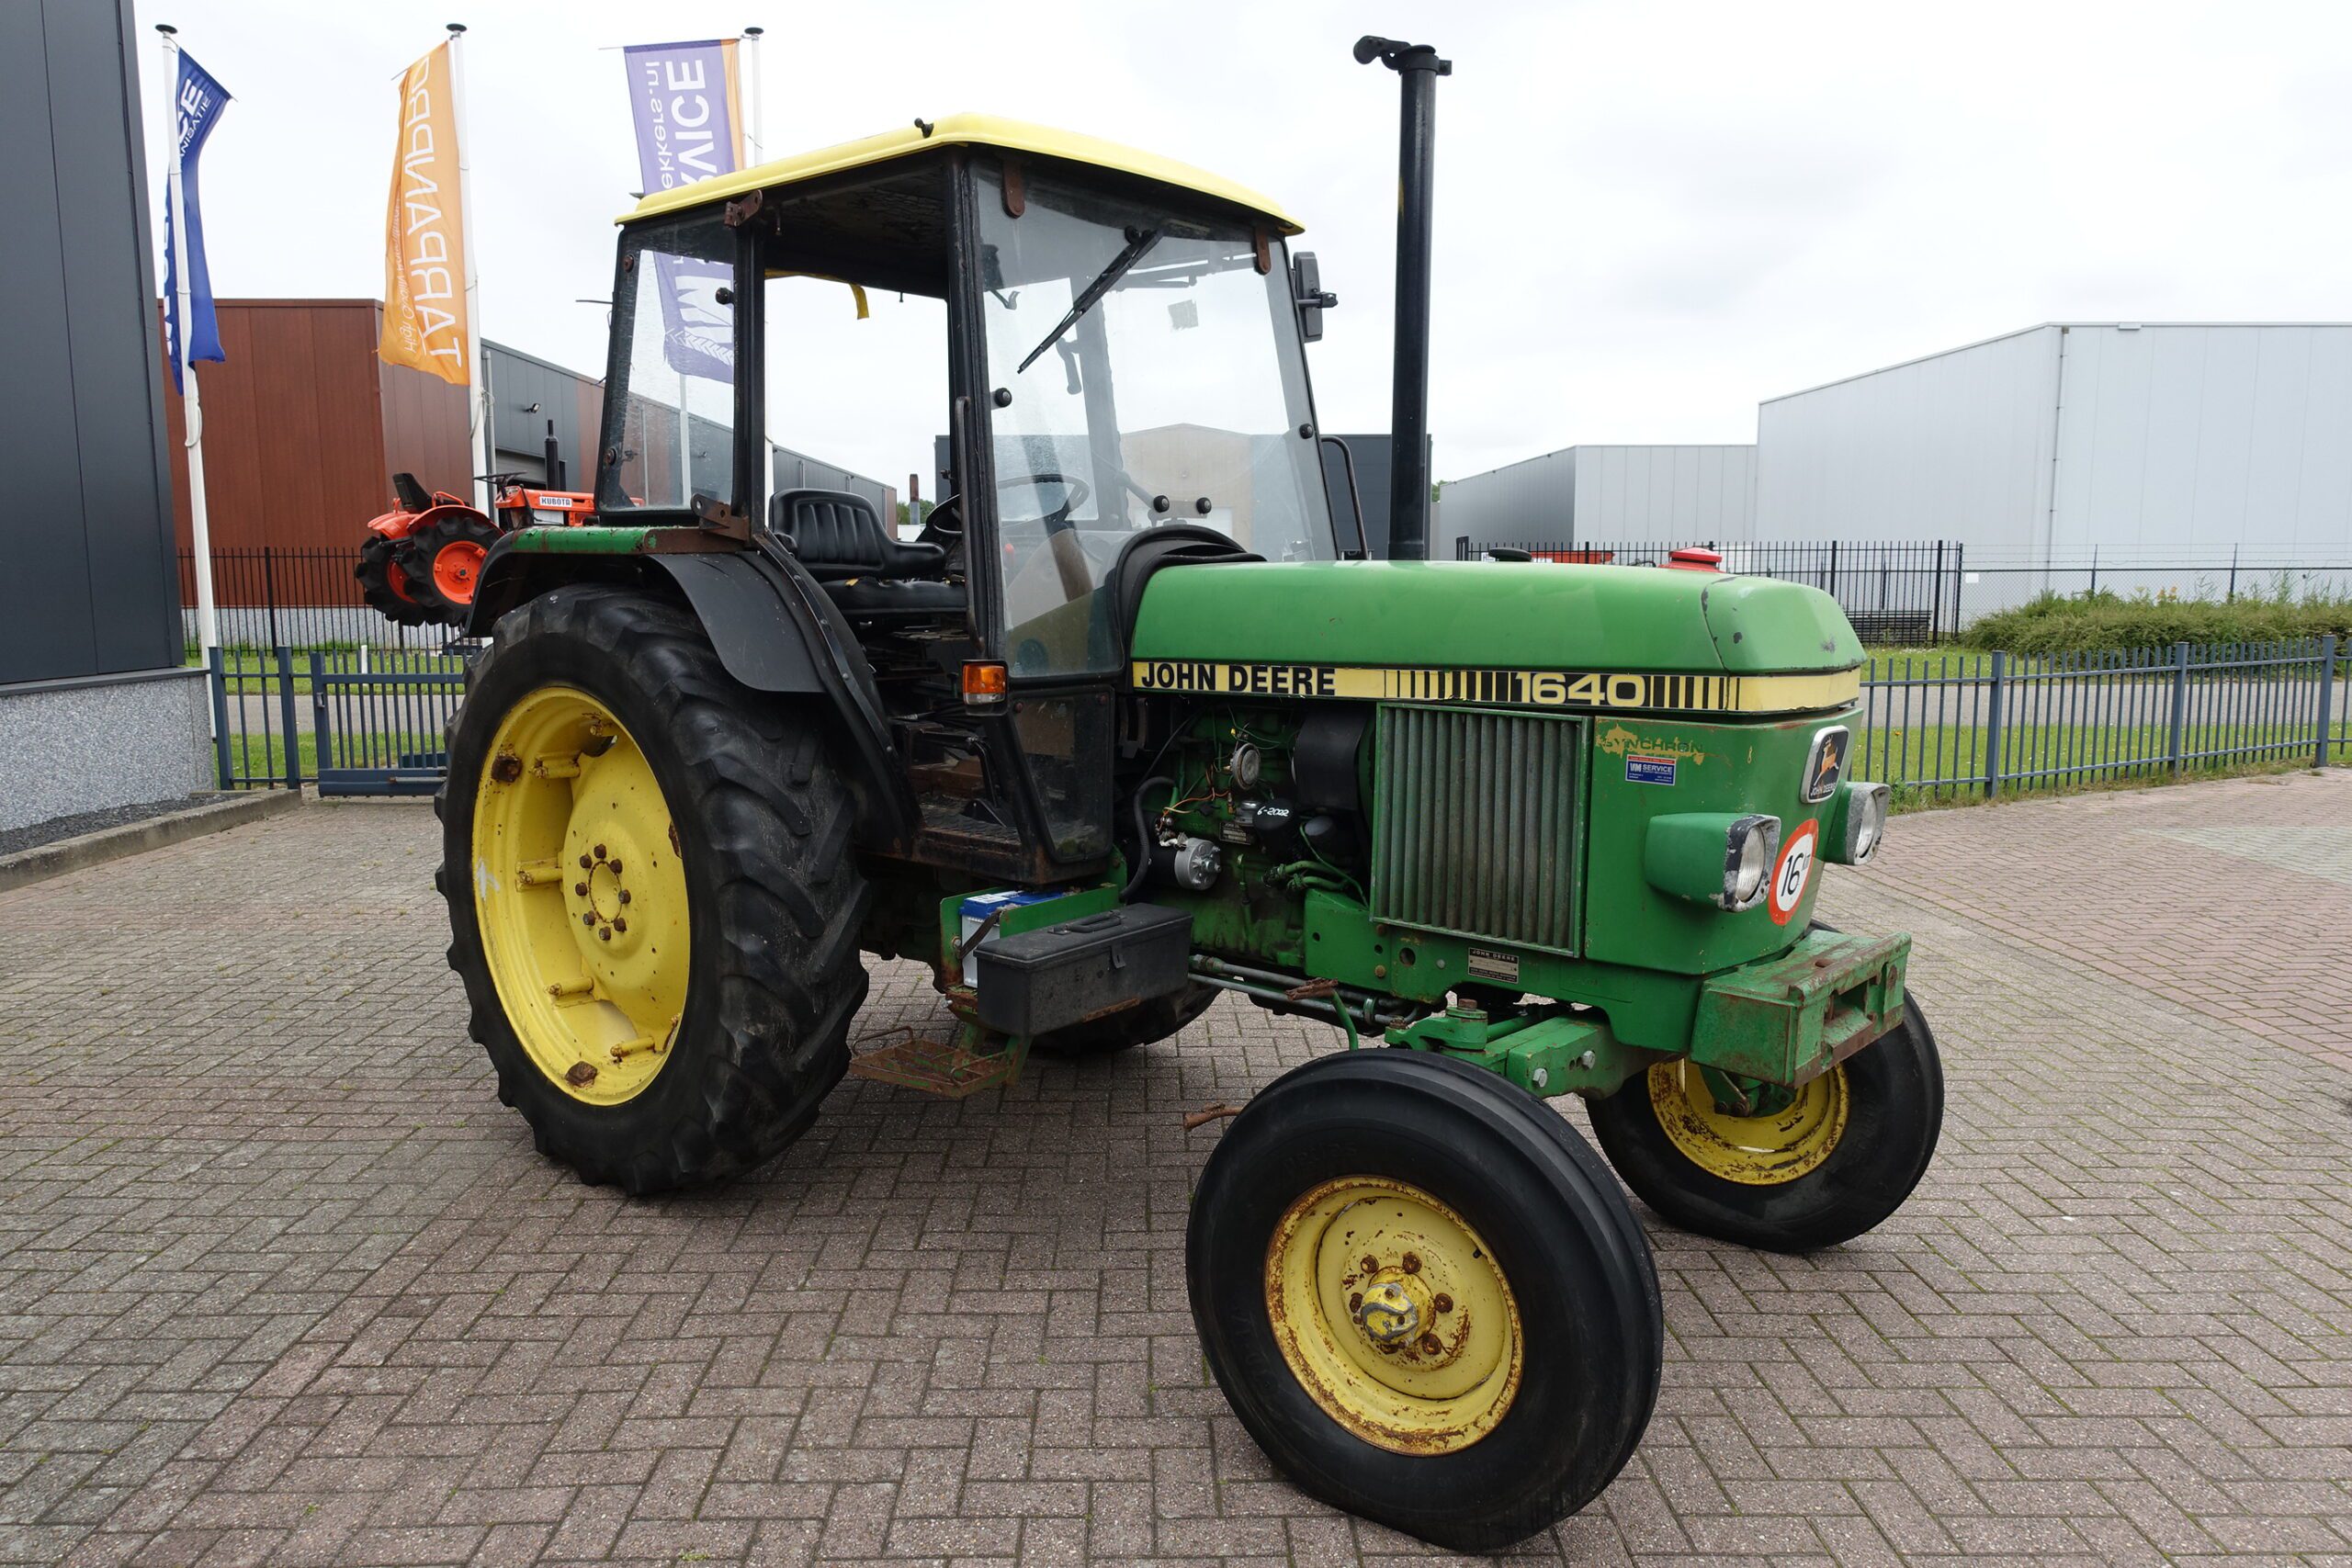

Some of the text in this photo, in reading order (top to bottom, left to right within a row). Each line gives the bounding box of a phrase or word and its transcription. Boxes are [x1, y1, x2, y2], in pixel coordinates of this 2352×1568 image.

[541, 497, 571, 506] KUBOTA
[1141, 662, 1336, 696] JOHN DEERE
[1516, 671, 1645, 707] 1640
[1642, 763, 1673, 773] SERVICE
[1781, 852, 1804, 897] 16
[1492, 953, 1515, 962] DEERE
